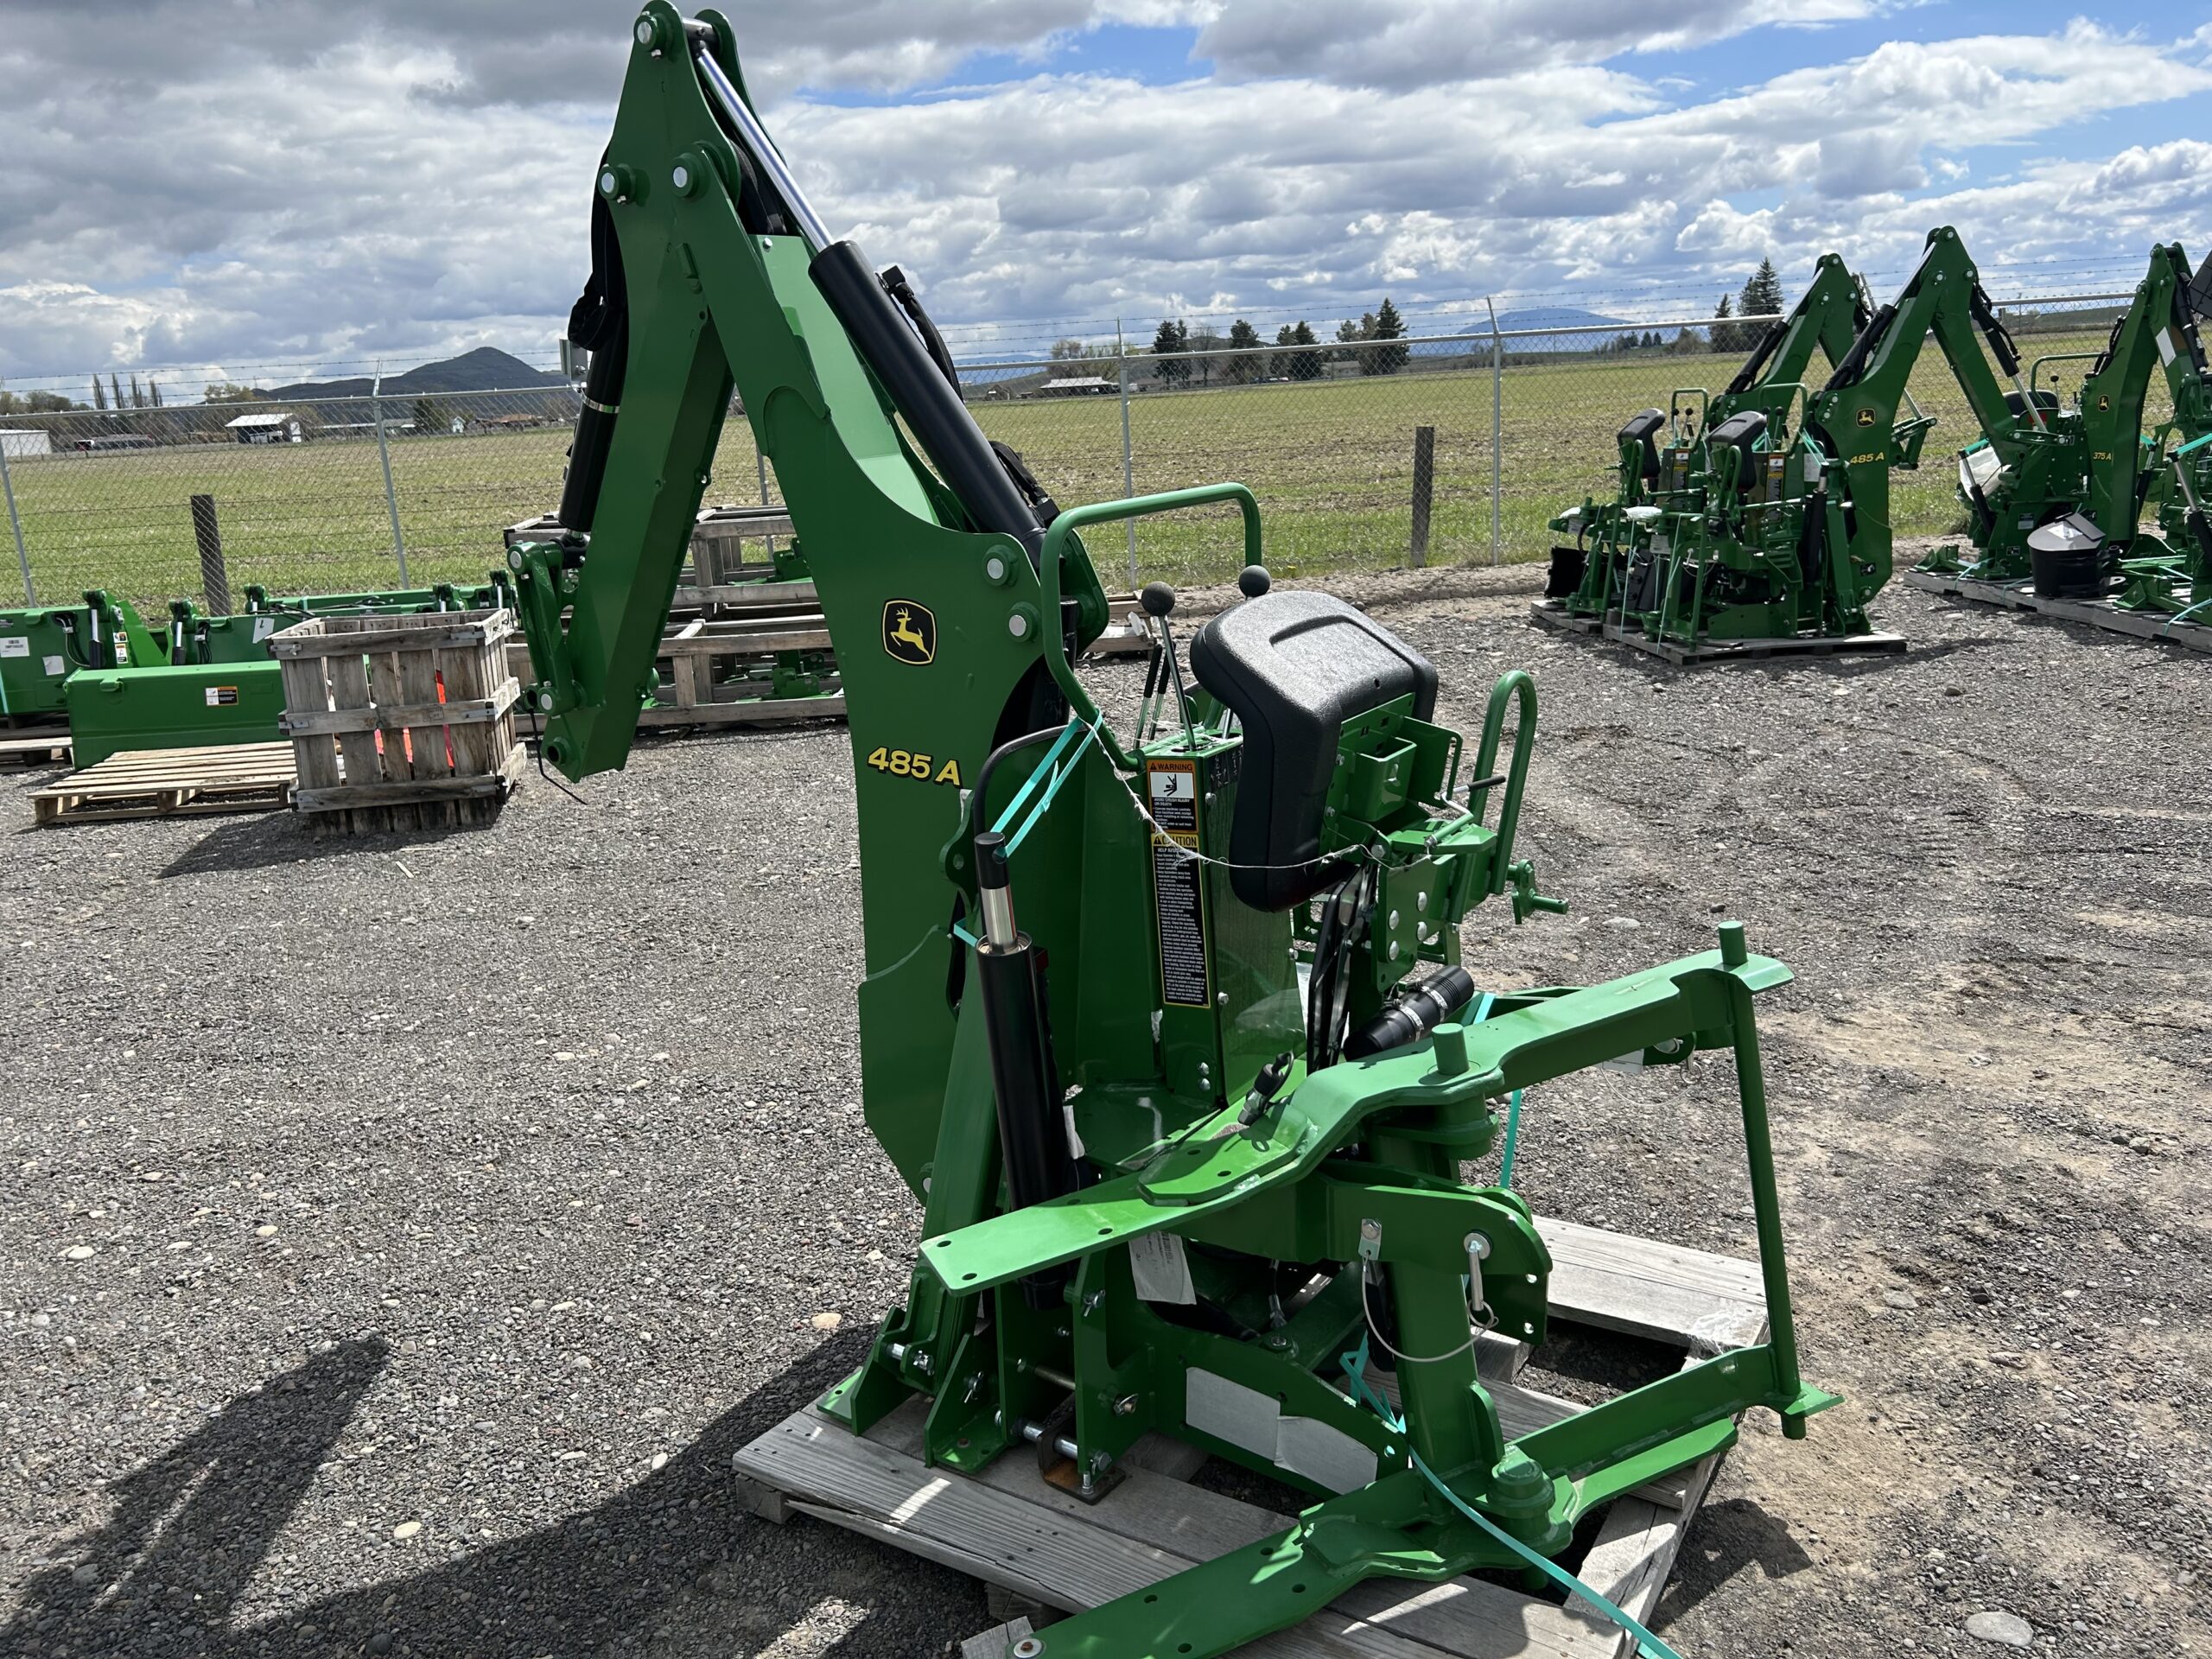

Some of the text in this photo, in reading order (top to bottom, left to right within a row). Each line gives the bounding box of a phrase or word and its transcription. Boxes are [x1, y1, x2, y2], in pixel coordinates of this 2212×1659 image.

[1850, 451, 1885, 464] 485 A
[2106, 452, 2112, 461] A
[868, 747, 962, 788] 485 A
[1162, 835, 1197, 846] CUTION
